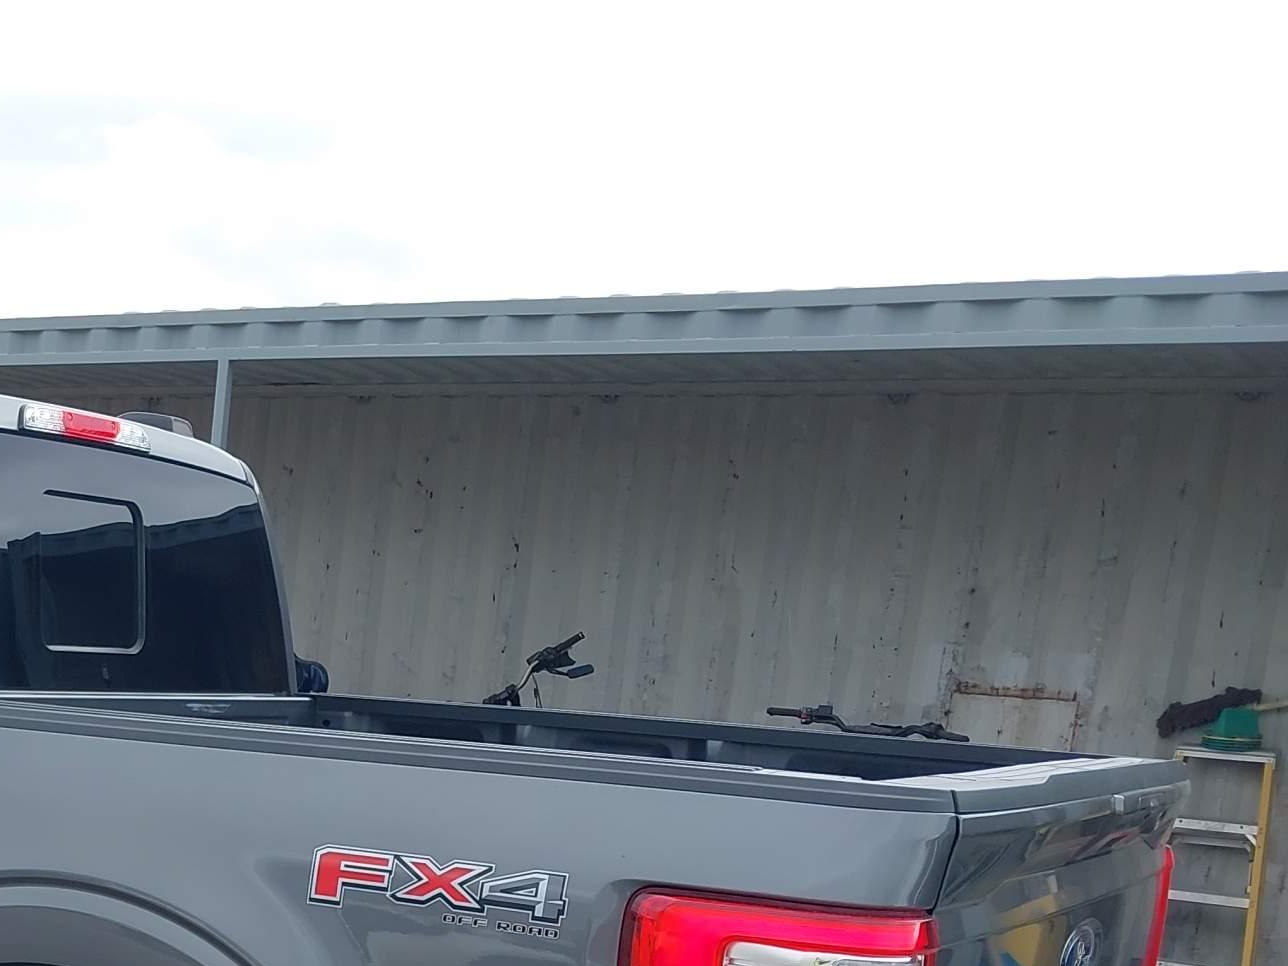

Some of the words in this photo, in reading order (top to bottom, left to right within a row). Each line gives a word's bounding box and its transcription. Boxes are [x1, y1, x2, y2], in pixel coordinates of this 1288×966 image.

[308, 844, 569, 925] FX4
[441, 912, 488, 929] OFF
[495, 920, 561, 940] ROAD
